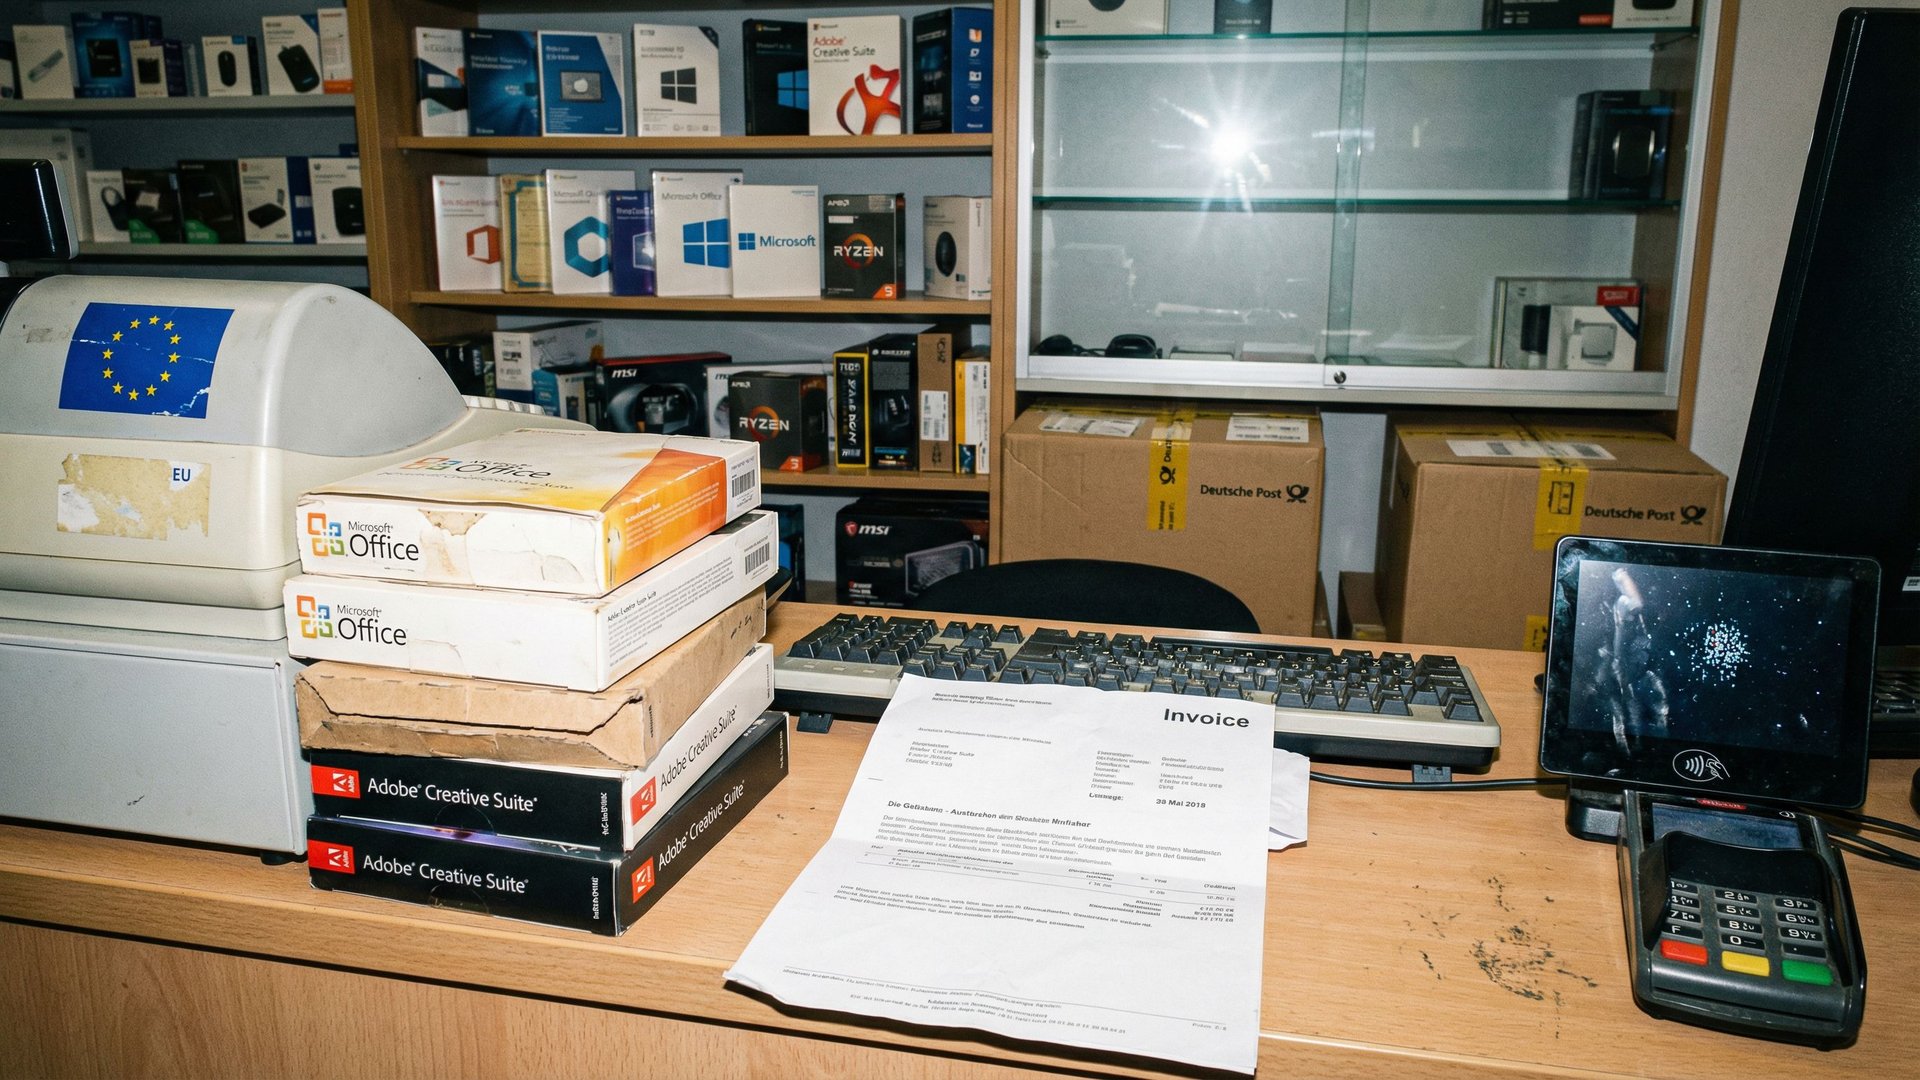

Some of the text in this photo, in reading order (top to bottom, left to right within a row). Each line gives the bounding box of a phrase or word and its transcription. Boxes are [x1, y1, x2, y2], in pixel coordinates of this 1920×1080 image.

[813, 37, 844, 46] Adobe
[813, 46, 876, 57] Creative Suite
[759, 235, 816, 248] Microsoft
[834, 246, 884, 257] RYZEN
[612, 368, 638, 379] msi
[739, 417, 789, 431] RYZEN
[172, 467, 191, 482] EU
[455, 463, 551, 479] Office
[1200, 484, 1282, 499] Deutsche Post
[1584, 505, 1675, 521] Deutsche Post
[348, 521, 391, 533] Microsoft
[859, 525, 890, 535] msi
[349, 534, 419, 561] Office
[337, 604, 380, 618] Microsoft
[338, 618, 407, 645] Office
[1164, 708, 1250, 728] Invoice
[660, 708, 736, 791] Adobe Creative Suite
[368, 778, 534, 812] Adobe Creative Suite
[658, 784, 744, 871] Adobe Creative Suite
[363, 855, 526, 893] Adobe Creative Suite
[1724, 891, 1735, 900] 2
[1725, 905, 1737, 914] 5
[1783, 899, 1795, 908] 3
[1728, 920, 1740, 929] 8
[1785, 913, 1797, 923] 6
[1788, 929, 1799, 937] 9
